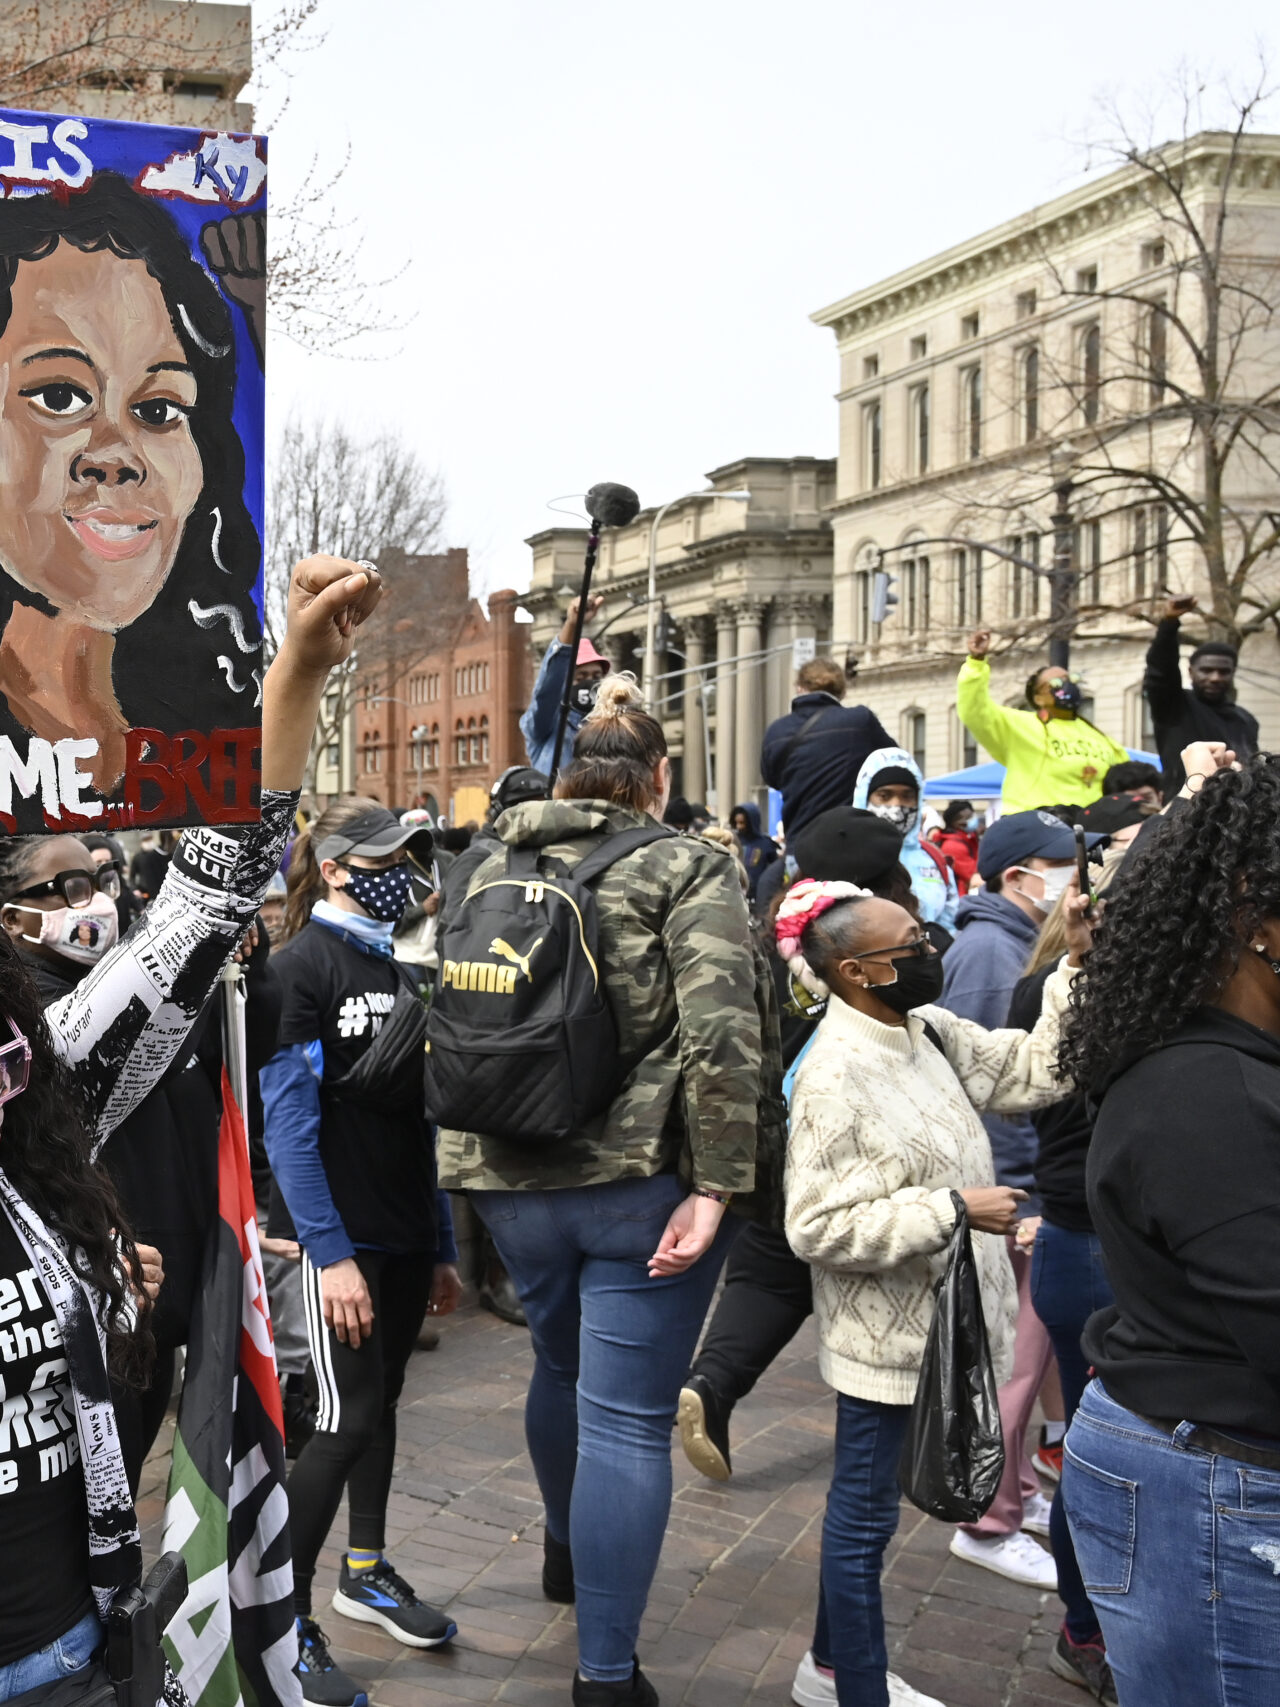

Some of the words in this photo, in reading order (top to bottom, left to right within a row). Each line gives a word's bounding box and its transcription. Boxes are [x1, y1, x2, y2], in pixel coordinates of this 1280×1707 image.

[441, 959, 518, 995] PUMA
[35, 1255, 63, 1292] sales
[90, 1413, 106, 1456] News
[38, 1430, 80, 1483] me
